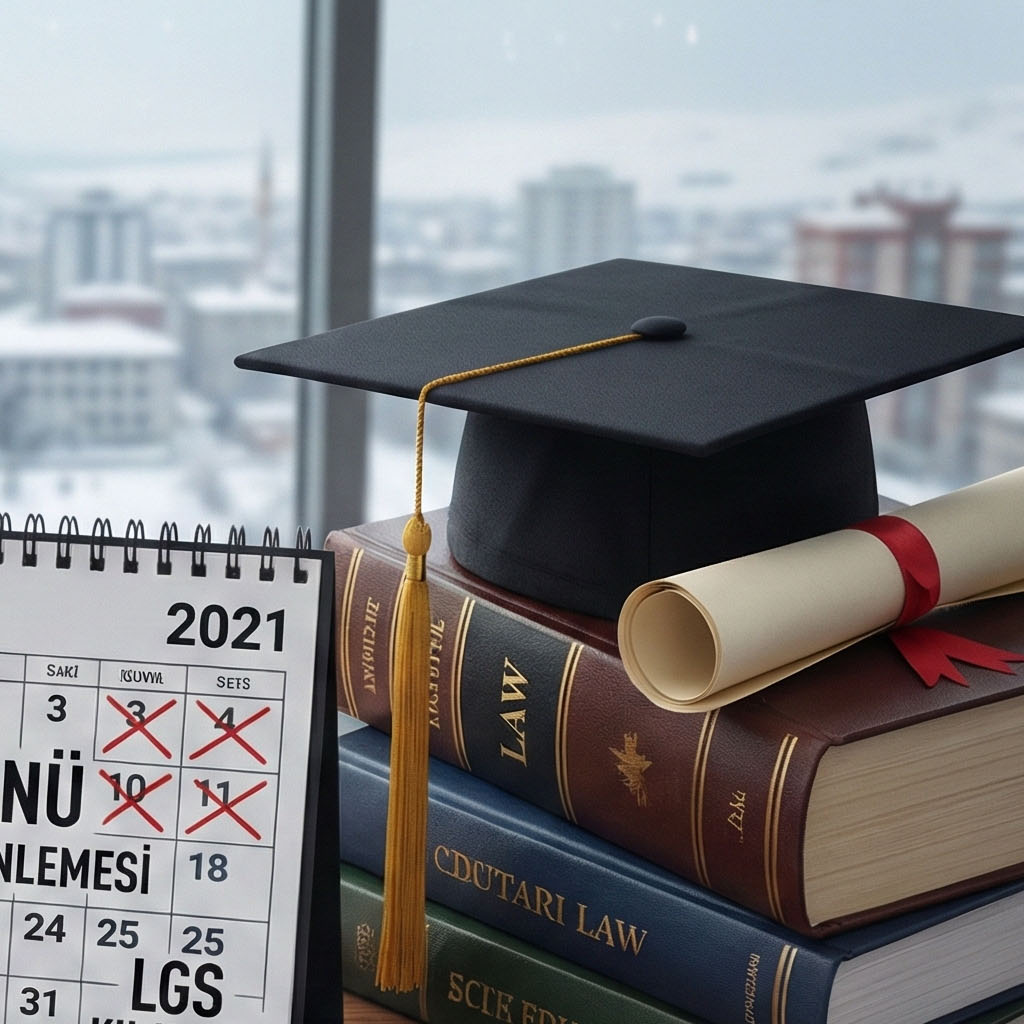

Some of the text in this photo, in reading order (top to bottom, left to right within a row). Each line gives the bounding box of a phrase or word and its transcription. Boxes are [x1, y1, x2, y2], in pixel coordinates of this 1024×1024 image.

[166, 602, 285, 652] 2021
[46, 694, 67, 722] 3
[125, 700, 146, 727] 3
[214, 706, 235, 731] 4
[499, 656, 530, 768] LAW
[107, 772, 230, 808] 10 11
[188, 852, 228, 883] 18
[23, 912, 66, 943] 24
[96, 918, 139, 950] 25
[181, 925, 224, 957] 25
[576, 903, 649, 958] LAW
[19, 986, 58, 1017] 31
[131, 957, 224, 1018] LGS
